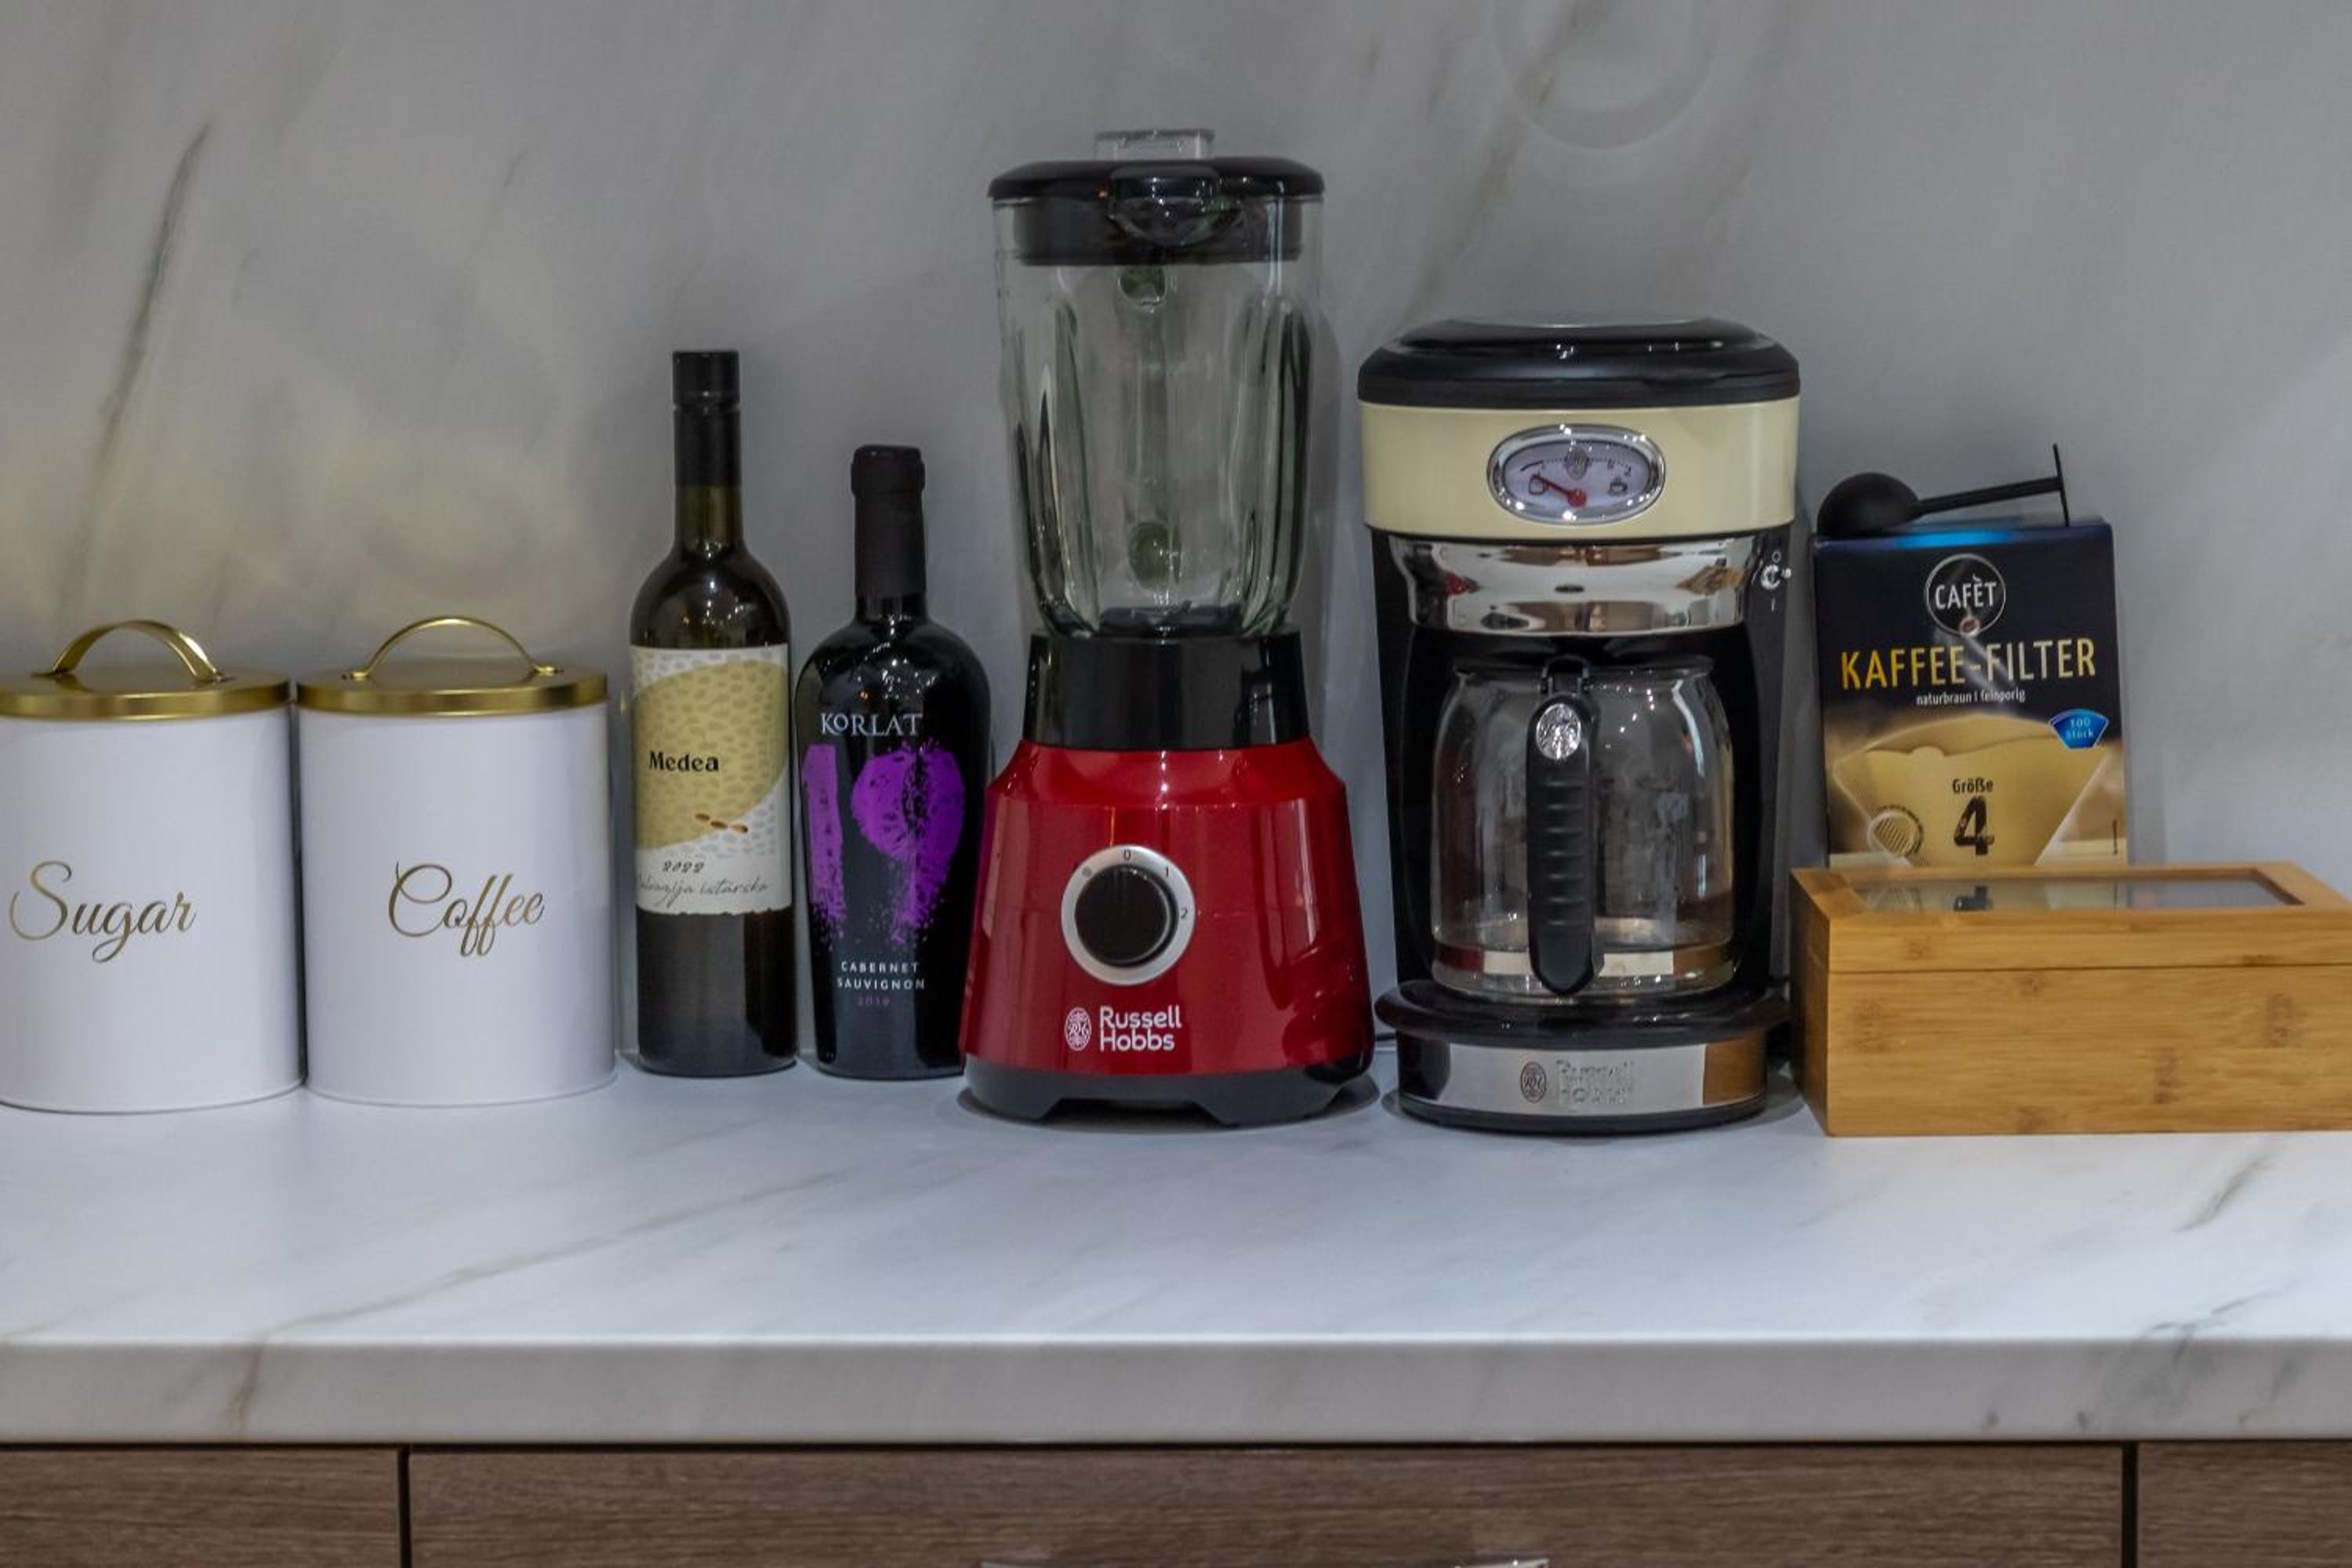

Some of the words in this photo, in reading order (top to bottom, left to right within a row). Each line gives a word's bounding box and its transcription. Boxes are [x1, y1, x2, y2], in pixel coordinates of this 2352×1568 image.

[1934, 574, 1998, 610] CAFÈT
[1842, 637, 2096, 691] KAFFEE-FILTER
[1916, 691, 1972, 706] naturbraun
[1980, 687, 2026, 703] feinporig
[820, 712, 923, 737] KORLAT
[2071, 717, 2091, 728] 100
[649, 750, 720, 772] Medea
[1952, 777, 1994, 794] Größe
[1954, 795, 1995, 855] 4
[9, 860, 197, 964] Sugar
[388, 861, 545, 957] Coffee
[1181, 908, 1189, 920] 2
[841, 960, 920, 974] CABERNET
[837, 977, 925, 991] SAUVIGNON
[1099, 1004, 1182, 1029] Russell
[1099, 1028, 1175, 1051] Hobbs
